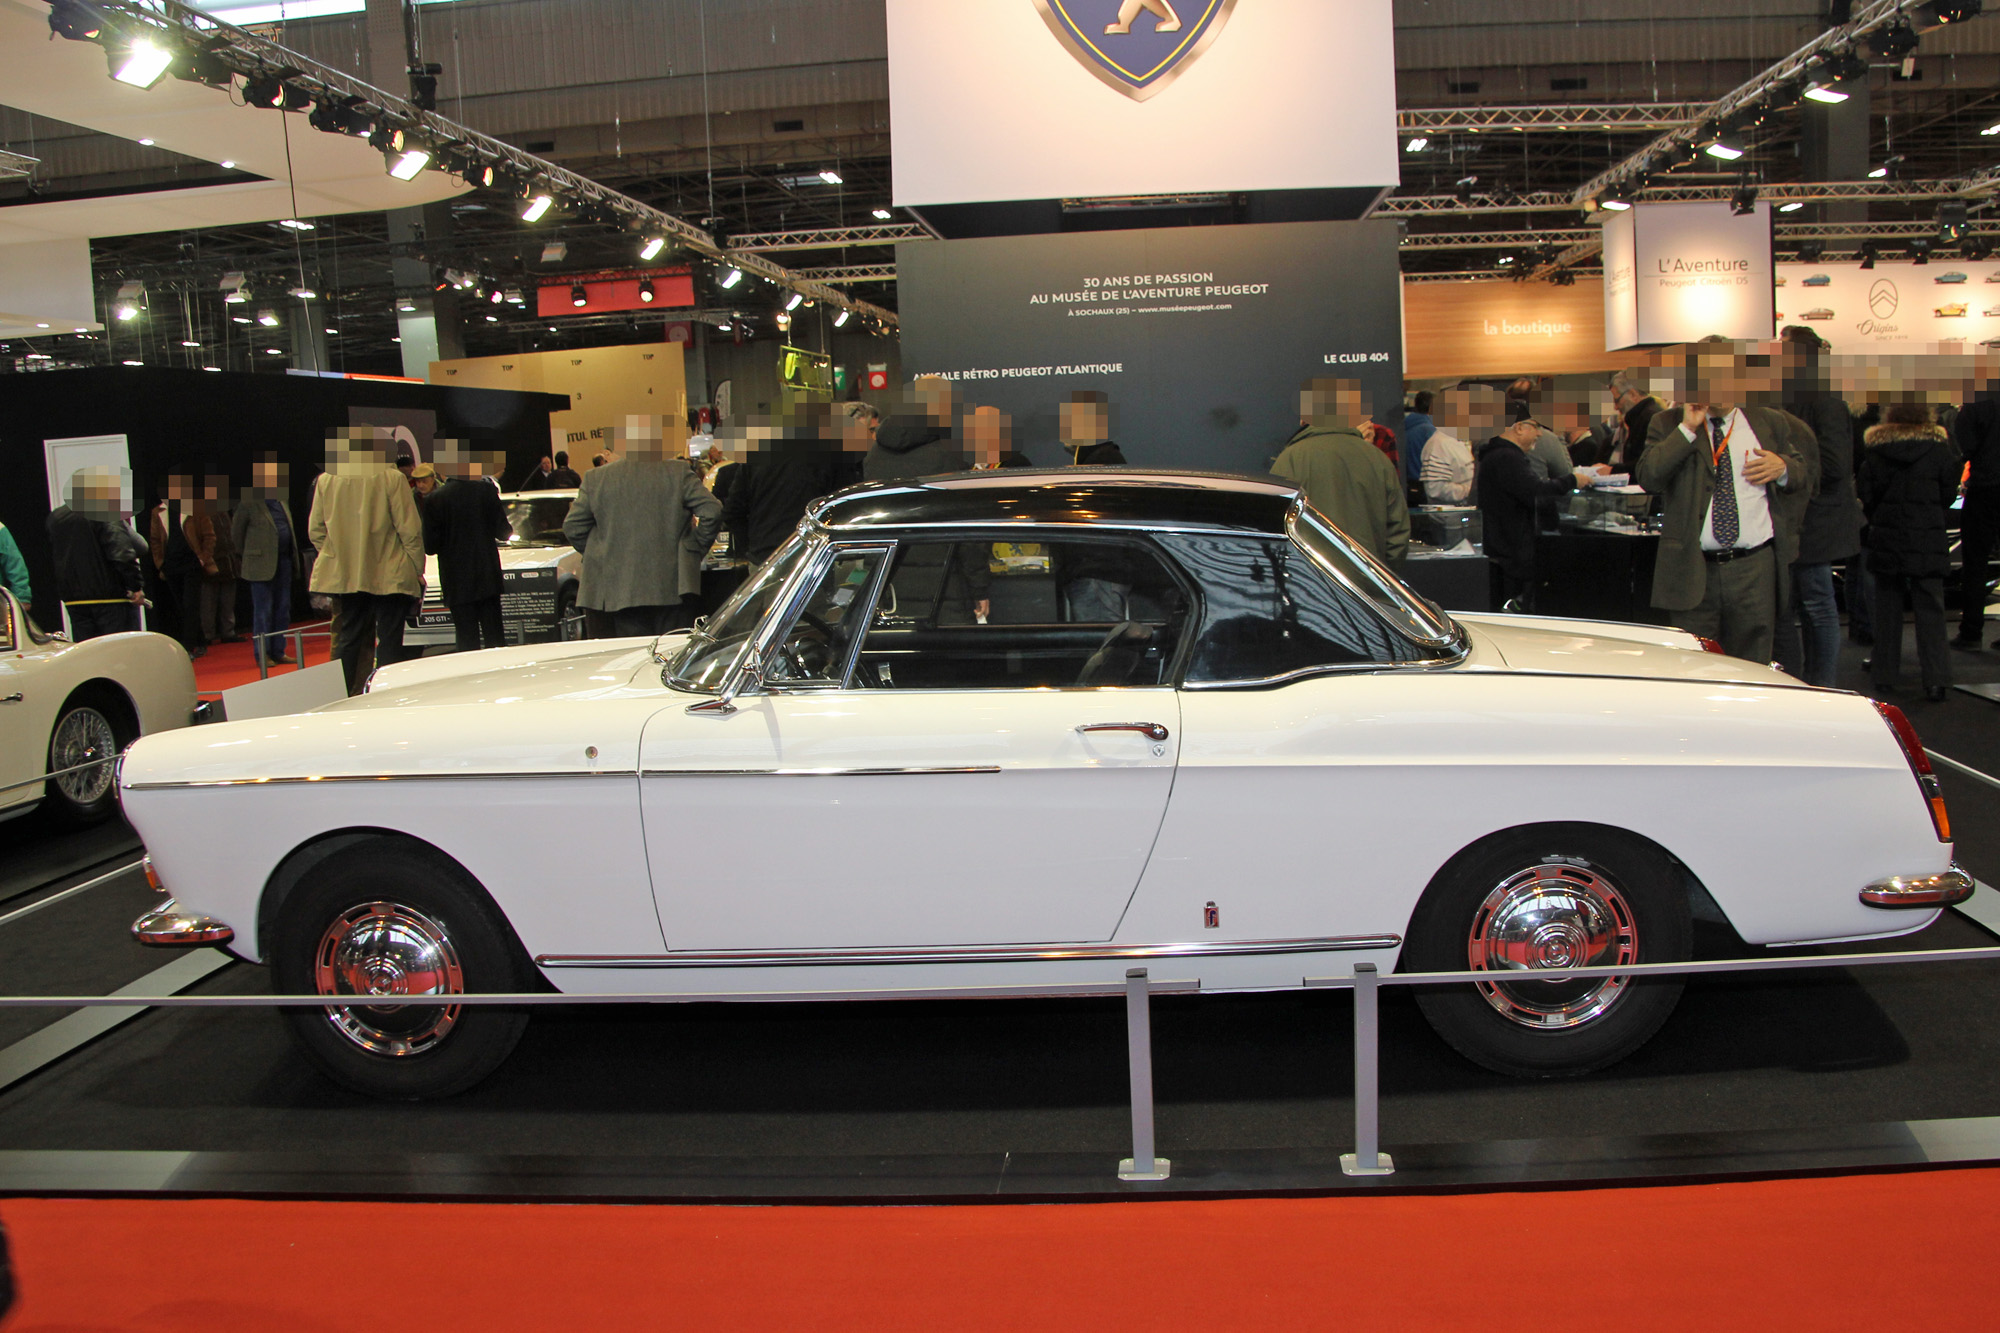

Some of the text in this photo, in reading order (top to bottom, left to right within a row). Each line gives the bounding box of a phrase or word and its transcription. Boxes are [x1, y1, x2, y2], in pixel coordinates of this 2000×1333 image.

[1083, 272, 1213, 288] 30 ANS DE PASSION
[1659, 276, 1749, 288] Peugeot Citroën DS
[1030, 283, 1270, 304] AU MUSÉE DE L'AVENTURE PEUGEOT
[1068, 309, 1074, 317] À
[1075, 308, 1115, 317] SOCHAUX
[1116, 307, 1130, 316] (25)
[1484, 319, 1572, 338] la boutique
[1856, 319, 1899, 336] Origins
[1324, 352, 1389, 364] LE CLUB 404
[963, 367, 999, 380] RÉTRO
[1001, 366, 1053, 378] PEUGEOT
[1055, 362, 1123, 375] ATLANTIQUE
[576, 392, 582, 401] 3
[647, 387, 653, 395] 4
[567, 427, 604, 443] ITUL RÉ
[503, 573, 516, 581] GTI
